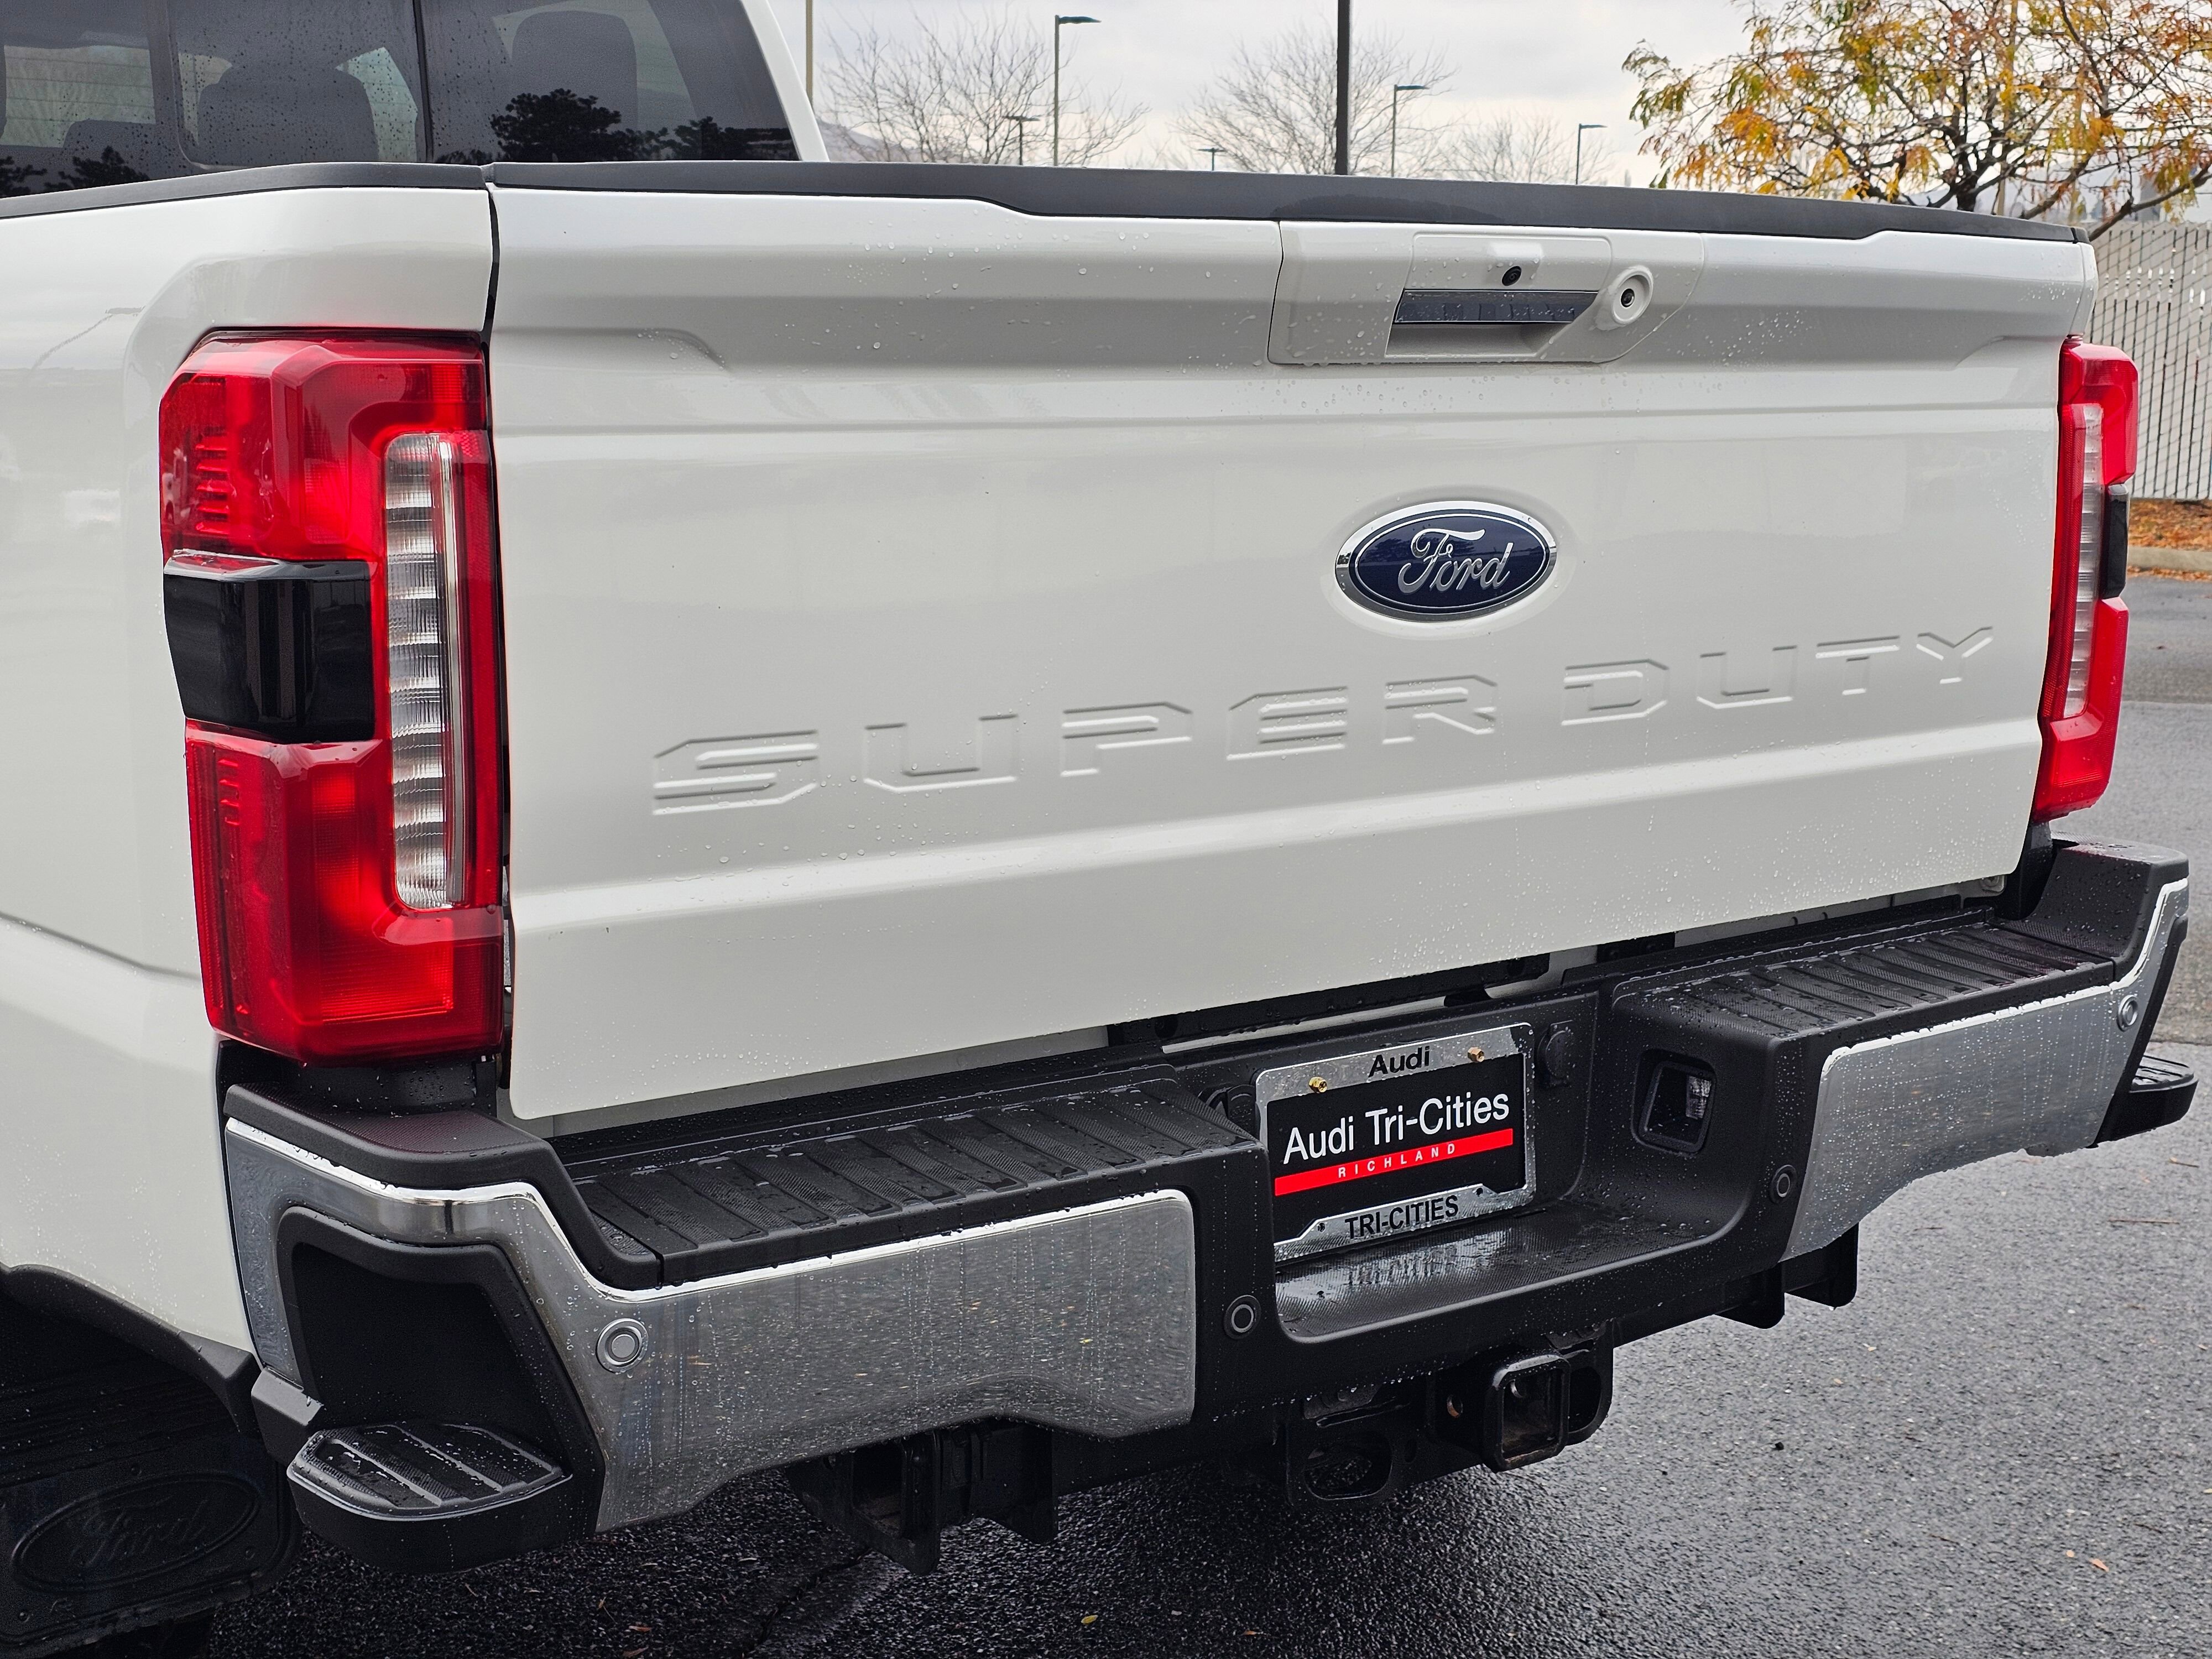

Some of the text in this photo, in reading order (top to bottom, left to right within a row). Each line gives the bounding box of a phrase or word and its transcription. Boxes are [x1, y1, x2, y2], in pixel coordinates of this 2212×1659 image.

[1397, 528, 1514, 594] Ford
[653, 626, 1994, 816] SUPER DUTY
[1367, 1045, 1431, 1078] Audi
[1283, 1092, 1510, 1165] Audi Tri-Cities
[1338, 1143, 1455, 1178] RICHLAND
[1344, 1194, 1459, 1239] TRI-CITIES
